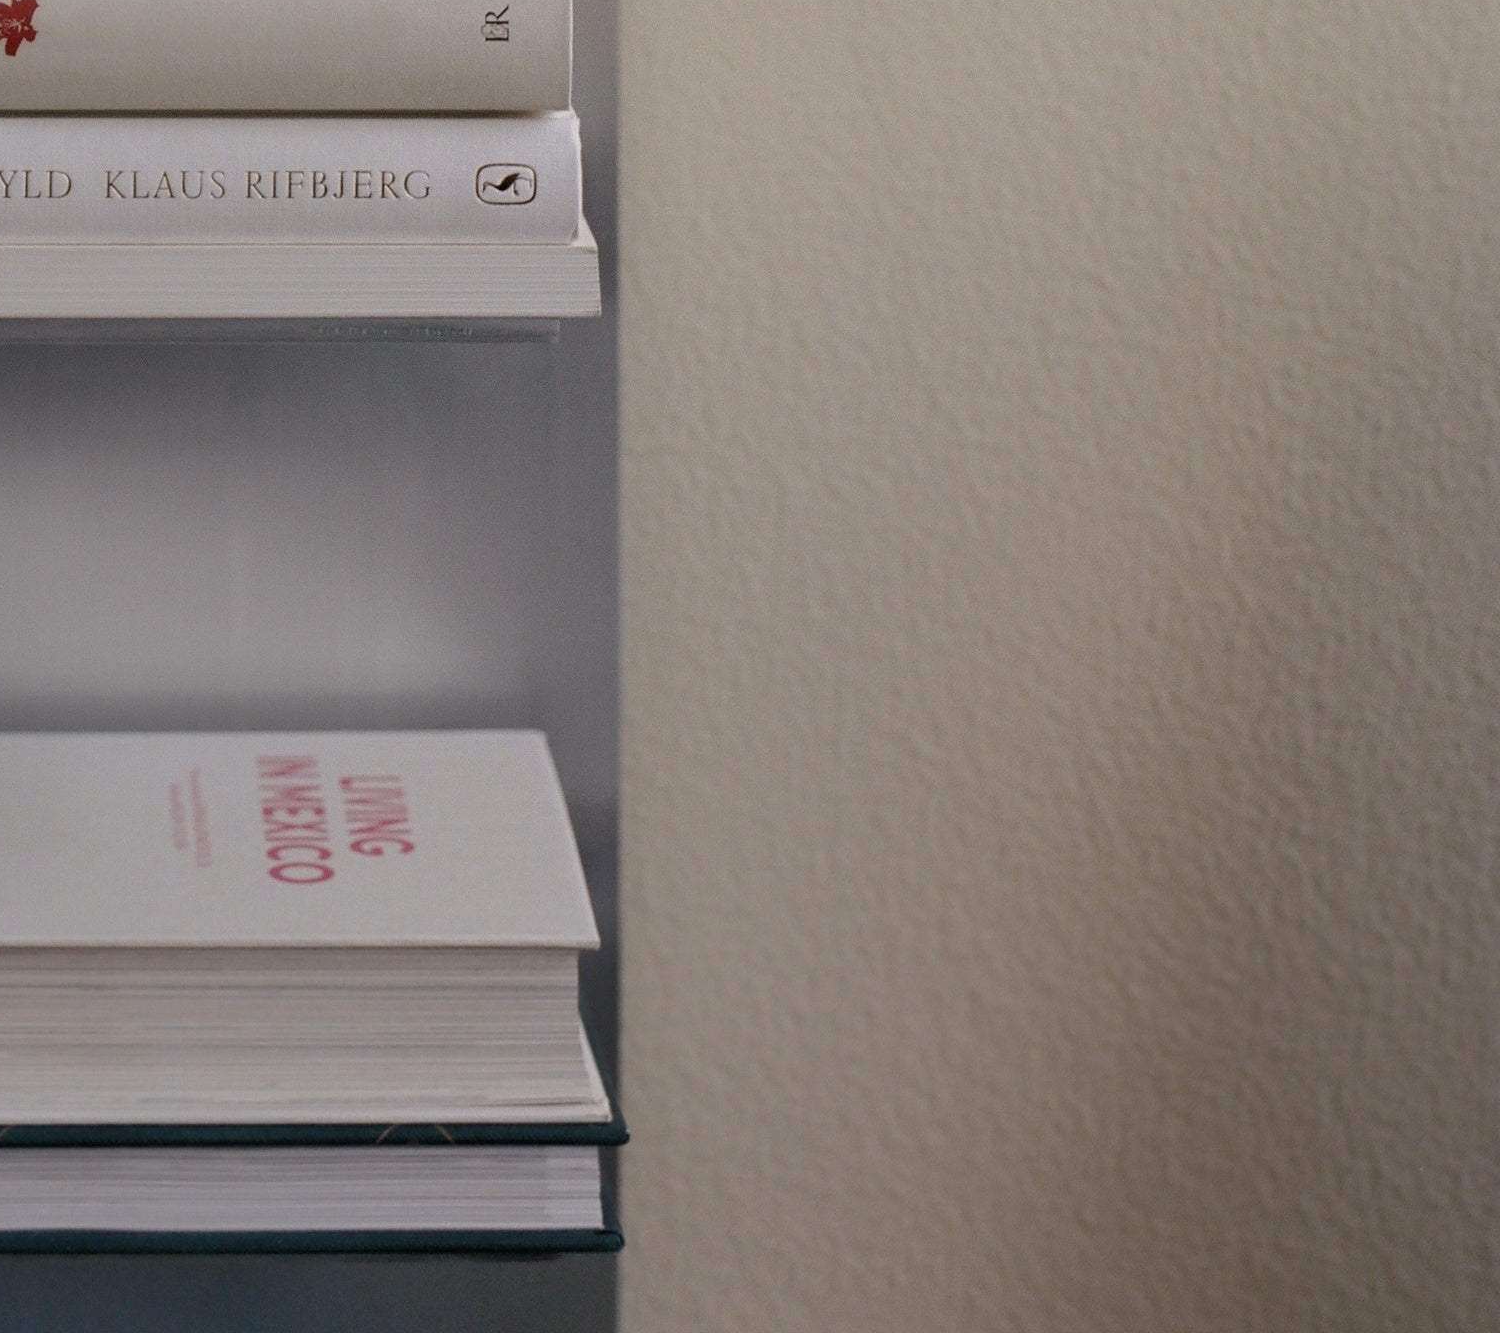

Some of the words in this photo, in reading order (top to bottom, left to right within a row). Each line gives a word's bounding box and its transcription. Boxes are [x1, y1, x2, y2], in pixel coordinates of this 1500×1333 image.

[105, 169, 227, 200] KLAUS
[245, 169, 432, 200] RIFBJERG
[255, 755, 322, 780] IN
[258, 783, 336, 884] MEXICO
[339, 775, 415, 857] LIVING
